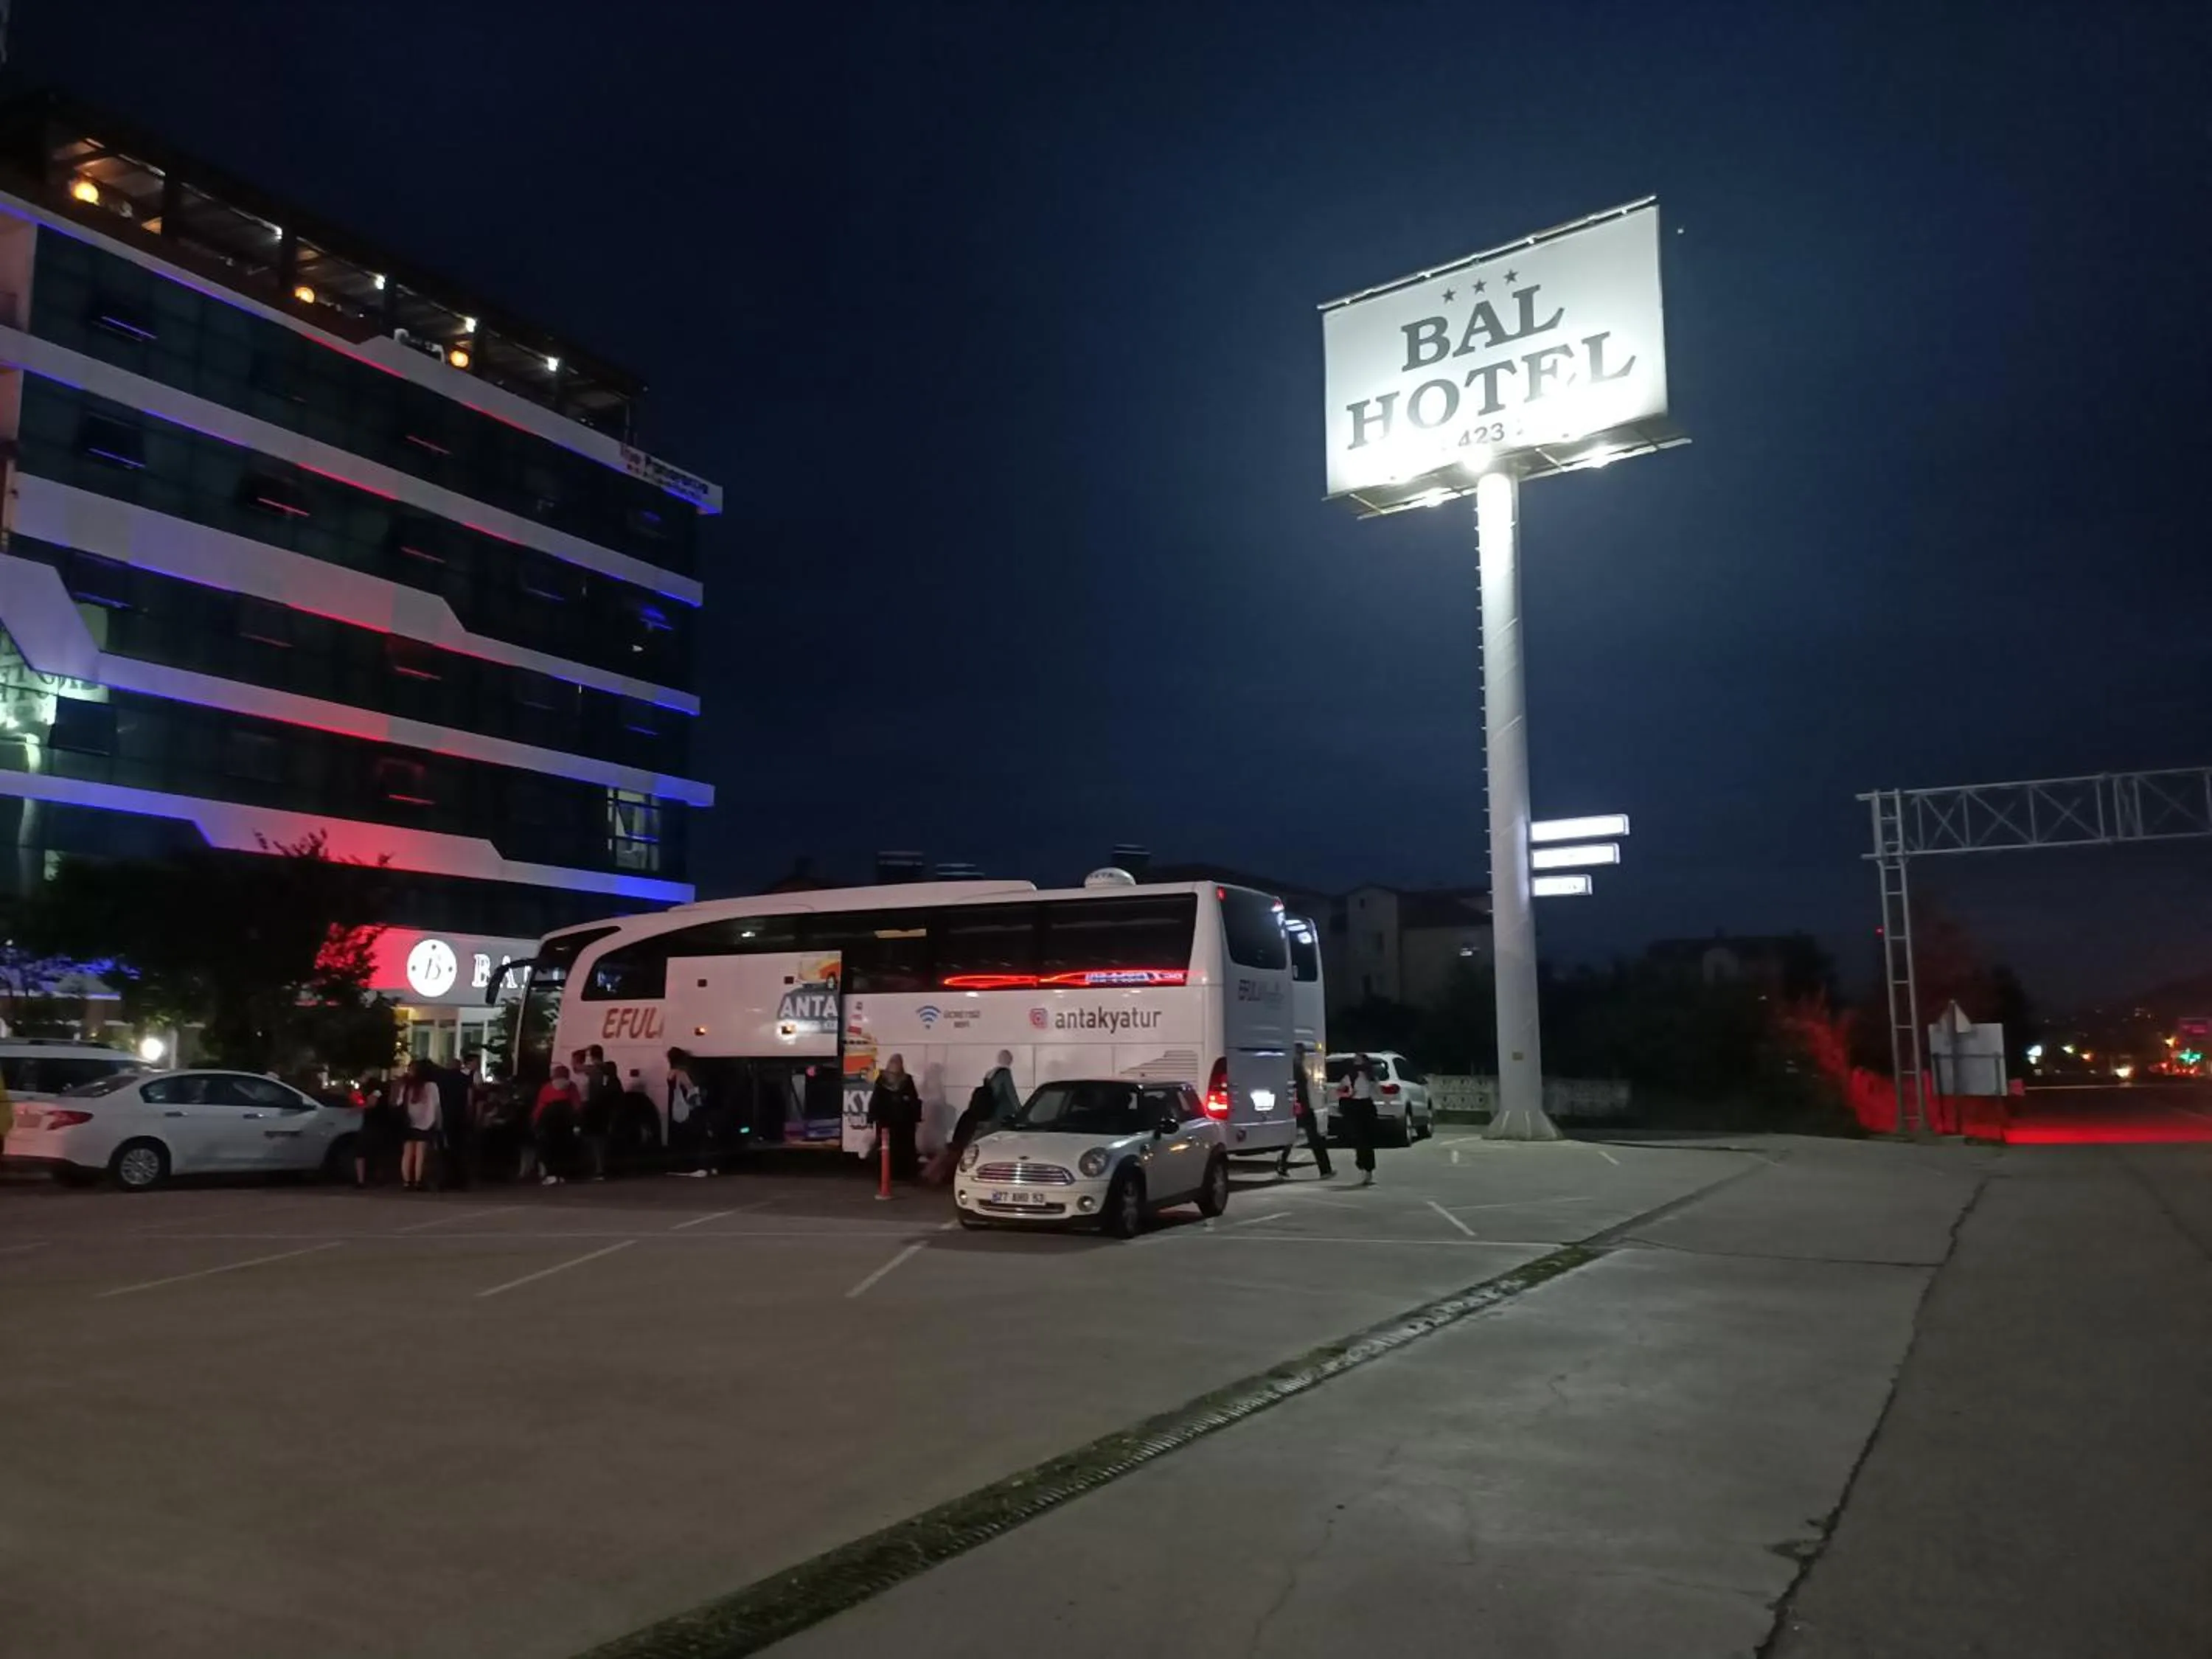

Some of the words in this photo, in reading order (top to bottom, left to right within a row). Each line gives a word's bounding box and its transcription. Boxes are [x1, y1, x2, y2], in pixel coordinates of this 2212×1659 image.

[1401, 285, 1565, 372] BAL
[1346, 331, 1636, 451] HOTEL
[780, 995, 838, 1018] ANTA
[1055, 1006, 1163, 1034] antakyatur
